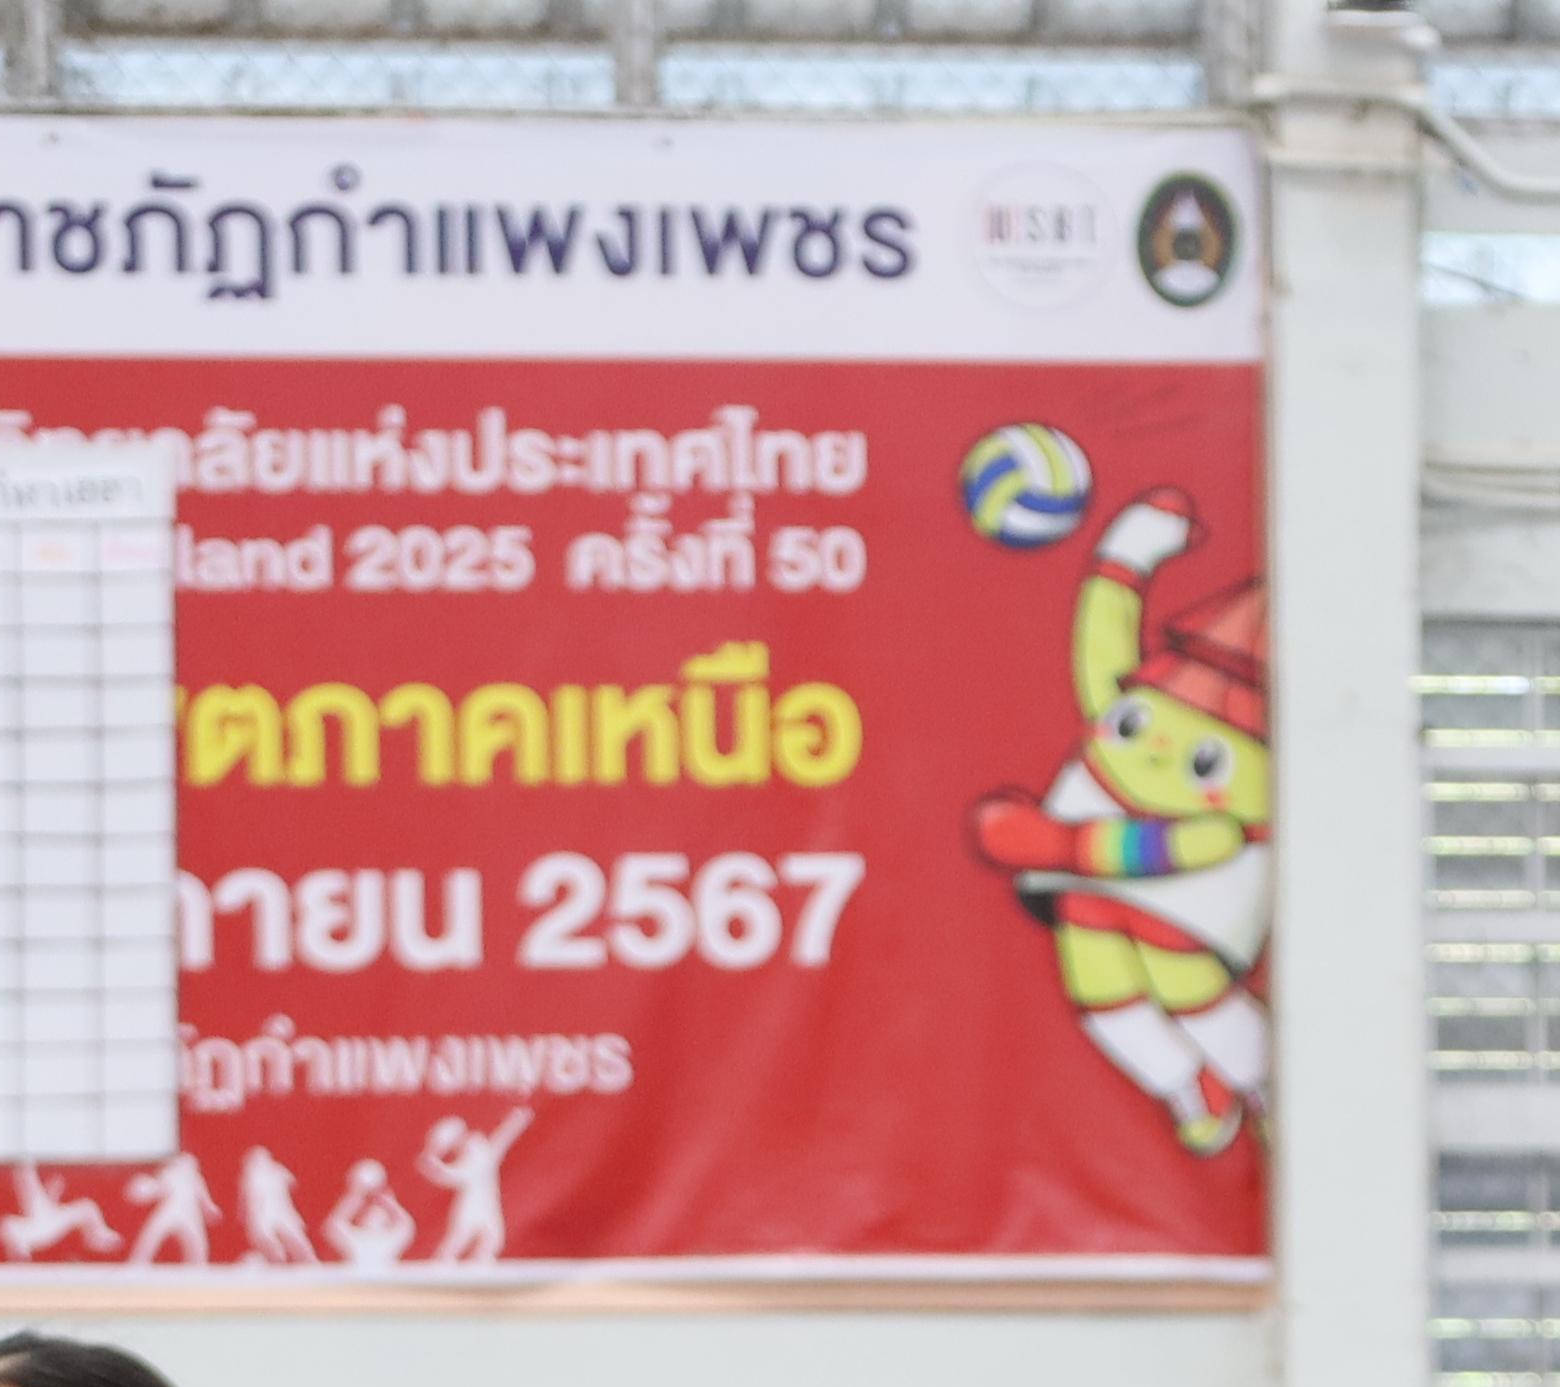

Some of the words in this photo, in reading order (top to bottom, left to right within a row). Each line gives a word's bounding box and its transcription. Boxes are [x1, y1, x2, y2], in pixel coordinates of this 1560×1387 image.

[176, 522, 334, 592] land
[345, 525, 535, 591] 2025
[567, 492, 755, 591] ครั้งที่
[770, 525, 868, 591] 50
[177, 641, 863, 788] ตภาคเหนือ
[517, 851, 867, 972] 2567
